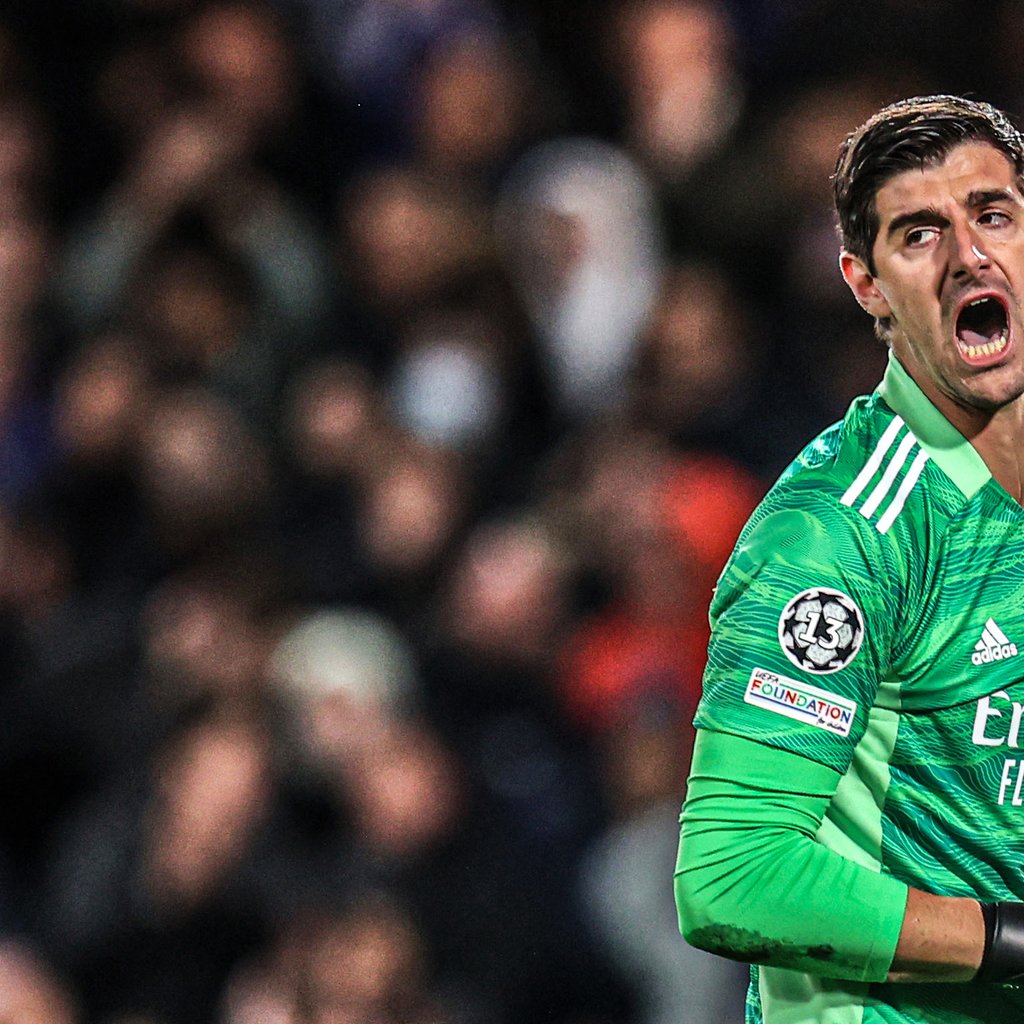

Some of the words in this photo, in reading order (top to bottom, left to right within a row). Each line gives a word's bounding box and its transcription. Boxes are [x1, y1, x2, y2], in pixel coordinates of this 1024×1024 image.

[798, 611, 844, 650] 13
[971, 643, 1018, 665] adidas
[755, 670, 780, 684] UEFA
[751, 679, 852, 724] FOUNDATION
